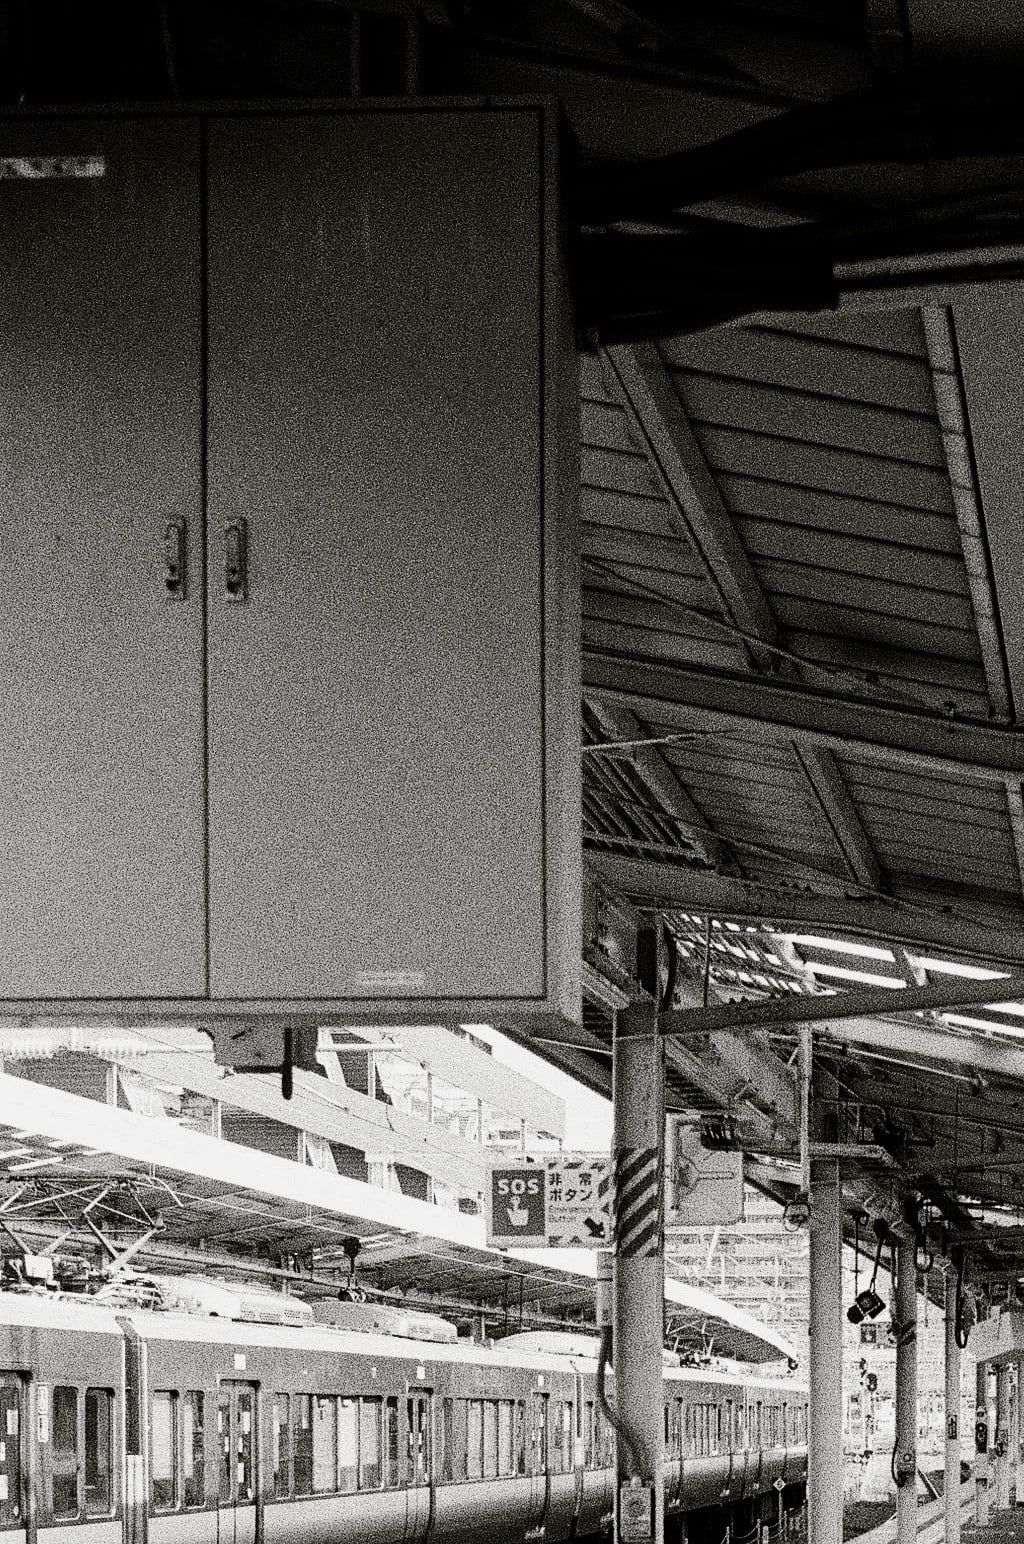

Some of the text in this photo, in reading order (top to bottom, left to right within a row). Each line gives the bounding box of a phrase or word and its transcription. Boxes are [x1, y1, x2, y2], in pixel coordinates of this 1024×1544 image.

[549, 1173, 592, 1186] 非常
[498, 1179, 539, 1195] SOS
[550, 1188, 593, 1201] ボタン
